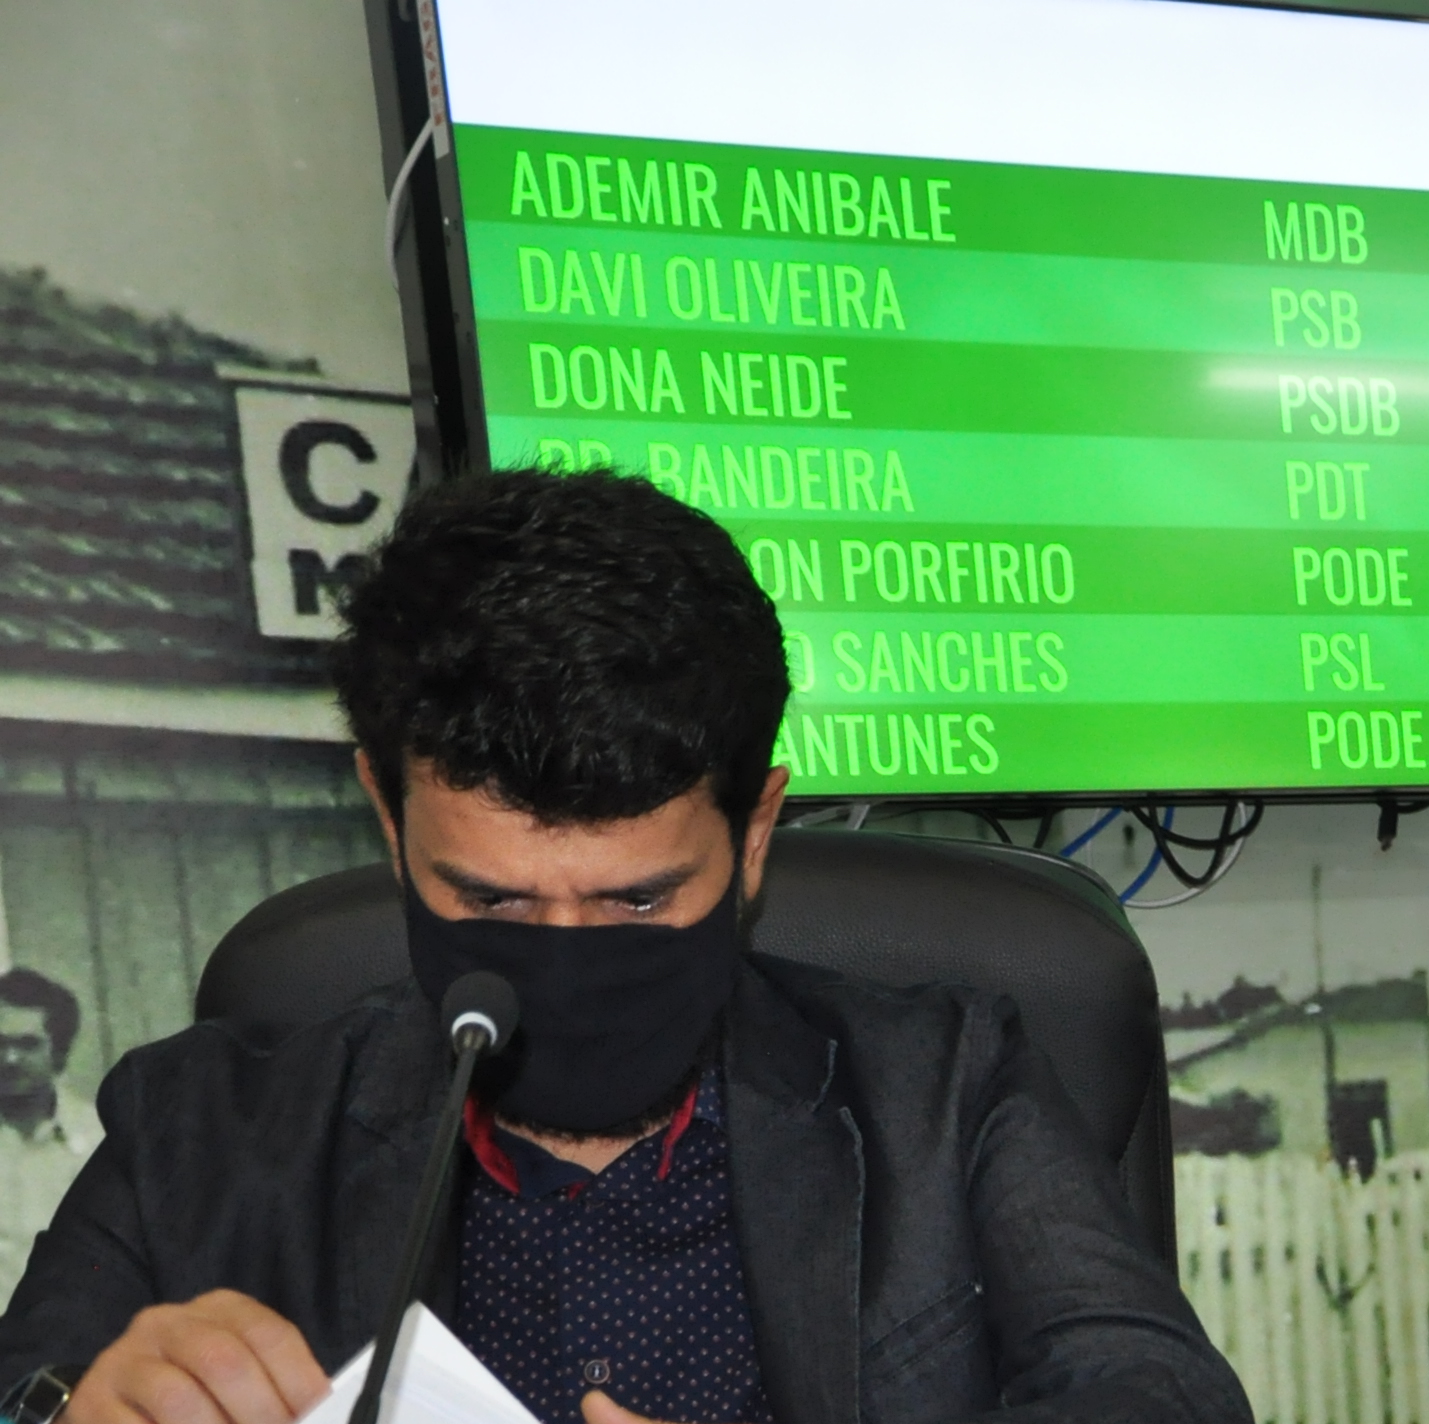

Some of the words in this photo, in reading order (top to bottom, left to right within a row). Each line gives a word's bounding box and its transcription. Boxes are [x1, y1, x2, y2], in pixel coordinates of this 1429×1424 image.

[511, 151, 722, 228] ADEMIR
[742, 167, 956, 243] ANIBALE
[1263, 201, 1369, 264] MDB
[518, 246, 648, 317] DAVI
[665, 255, 905, 330] OLIVEIRA
[1271, 287, 1361, 350] PSB
[529, 342, 685, 415] DONA
[700, 351, 852, 419] NEIDE
[1278, 373, 1400, 437] PSDB
[648, 442, 914, 513] BANDEIRA
[1286, 461, 1370, 522] PDT
[751, 538, 825, 603] ON
[839, 540, 1075, 604] PORFIRIO
[1292, 546, 1412, 607] PODE
[835, 631, 1068, 694] SANCHES
[1300, 632, 1385, 692] PSL
[771, 713, 999, 776] ANTUNES
[1307, 711, 1427, 770] PODE
